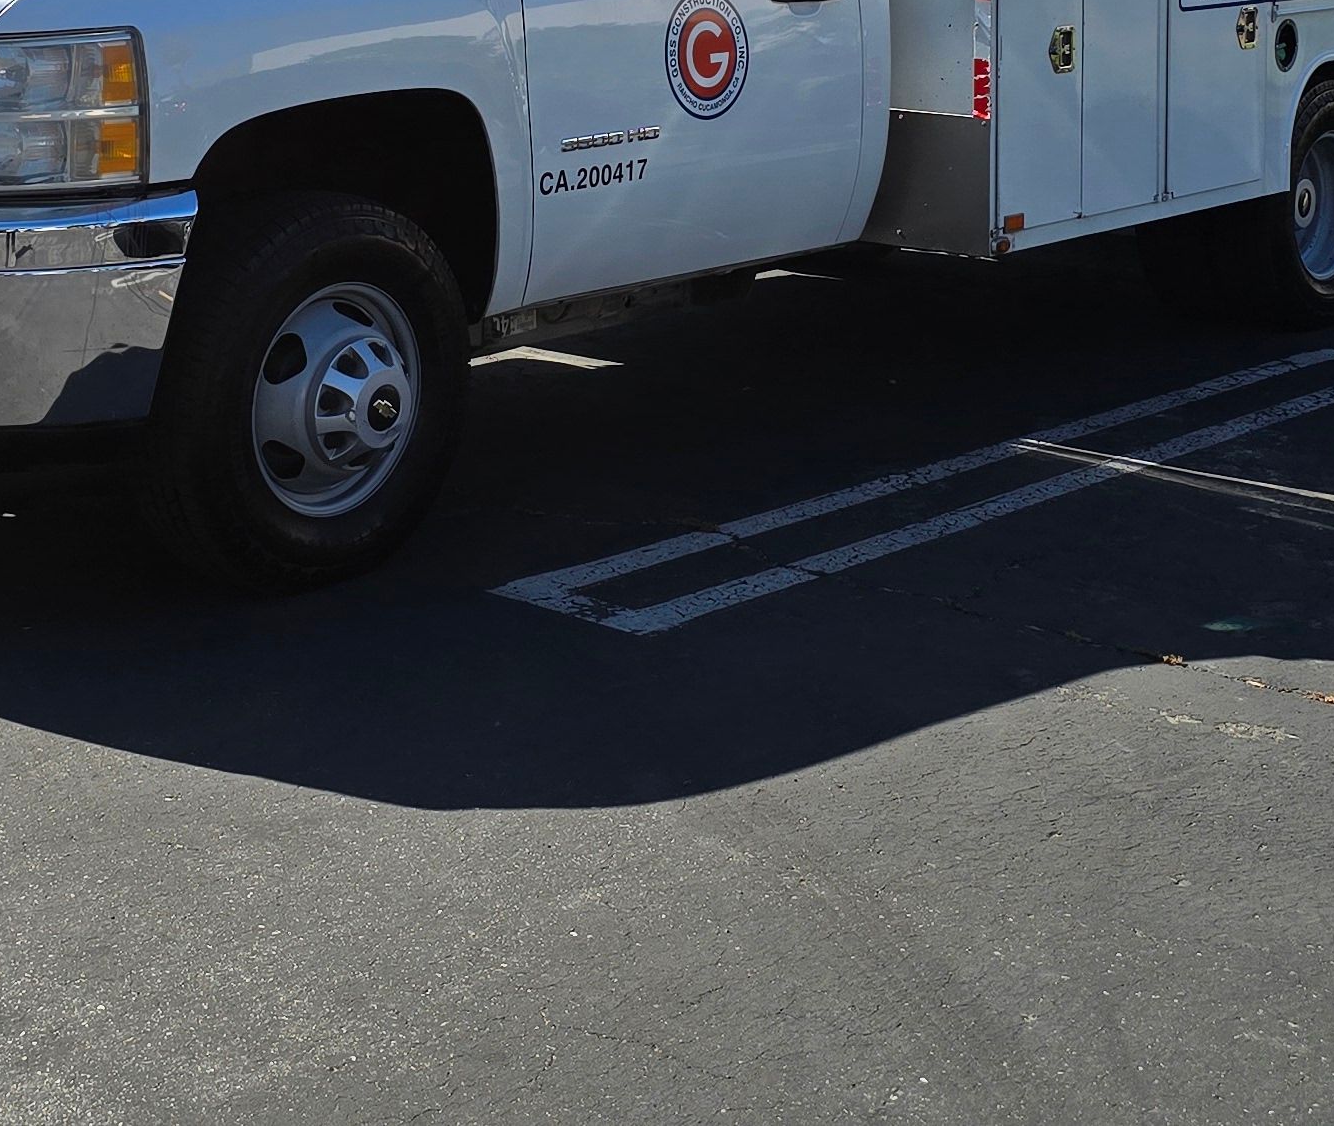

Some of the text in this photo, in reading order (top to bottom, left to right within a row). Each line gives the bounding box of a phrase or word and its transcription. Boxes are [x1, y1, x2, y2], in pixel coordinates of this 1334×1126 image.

[669, 40, 679, 78] GOSS
[737, 45, 745, 72] INC.
[686, 20, 730, 88] G
[677, 82, 698, 109] RANCHO
[732, 77, 740, 89] CA
[539, 158, 648, 196] CA.200417
